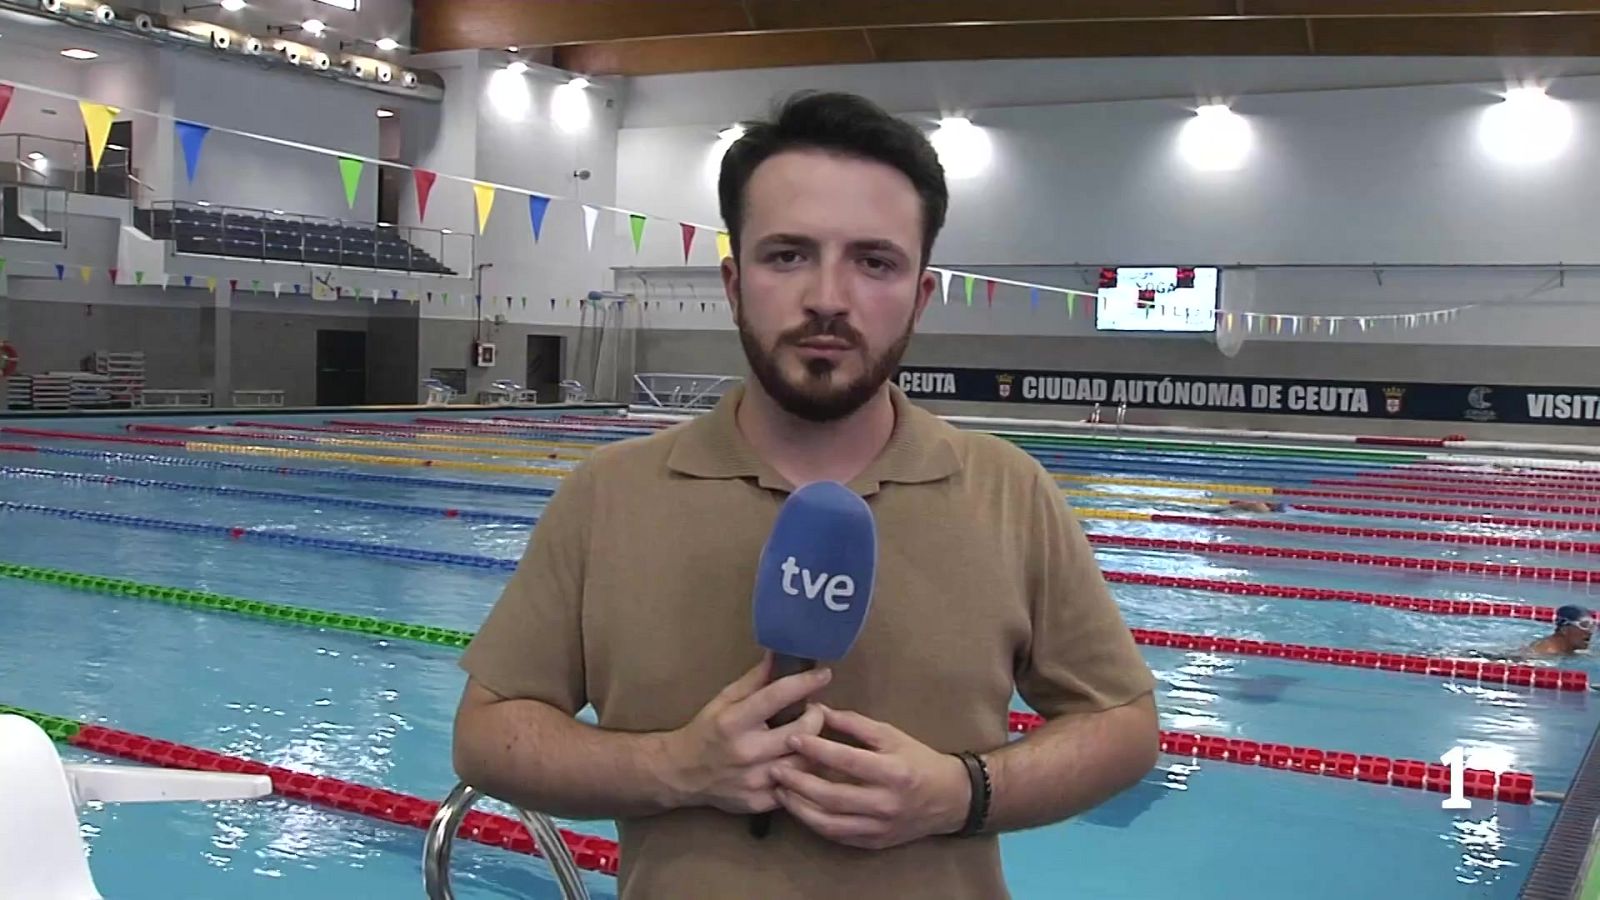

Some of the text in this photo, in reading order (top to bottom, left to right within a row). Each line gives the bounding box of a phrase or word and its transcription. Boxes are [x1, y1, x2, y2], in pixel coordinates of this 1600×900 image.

[899, 371, 956, 393] CEUTA
[1022, 376, 1368, 412] CIUDAD AUTÓNOMA DE CEUTA
[781, 557, 855, 611] tve
